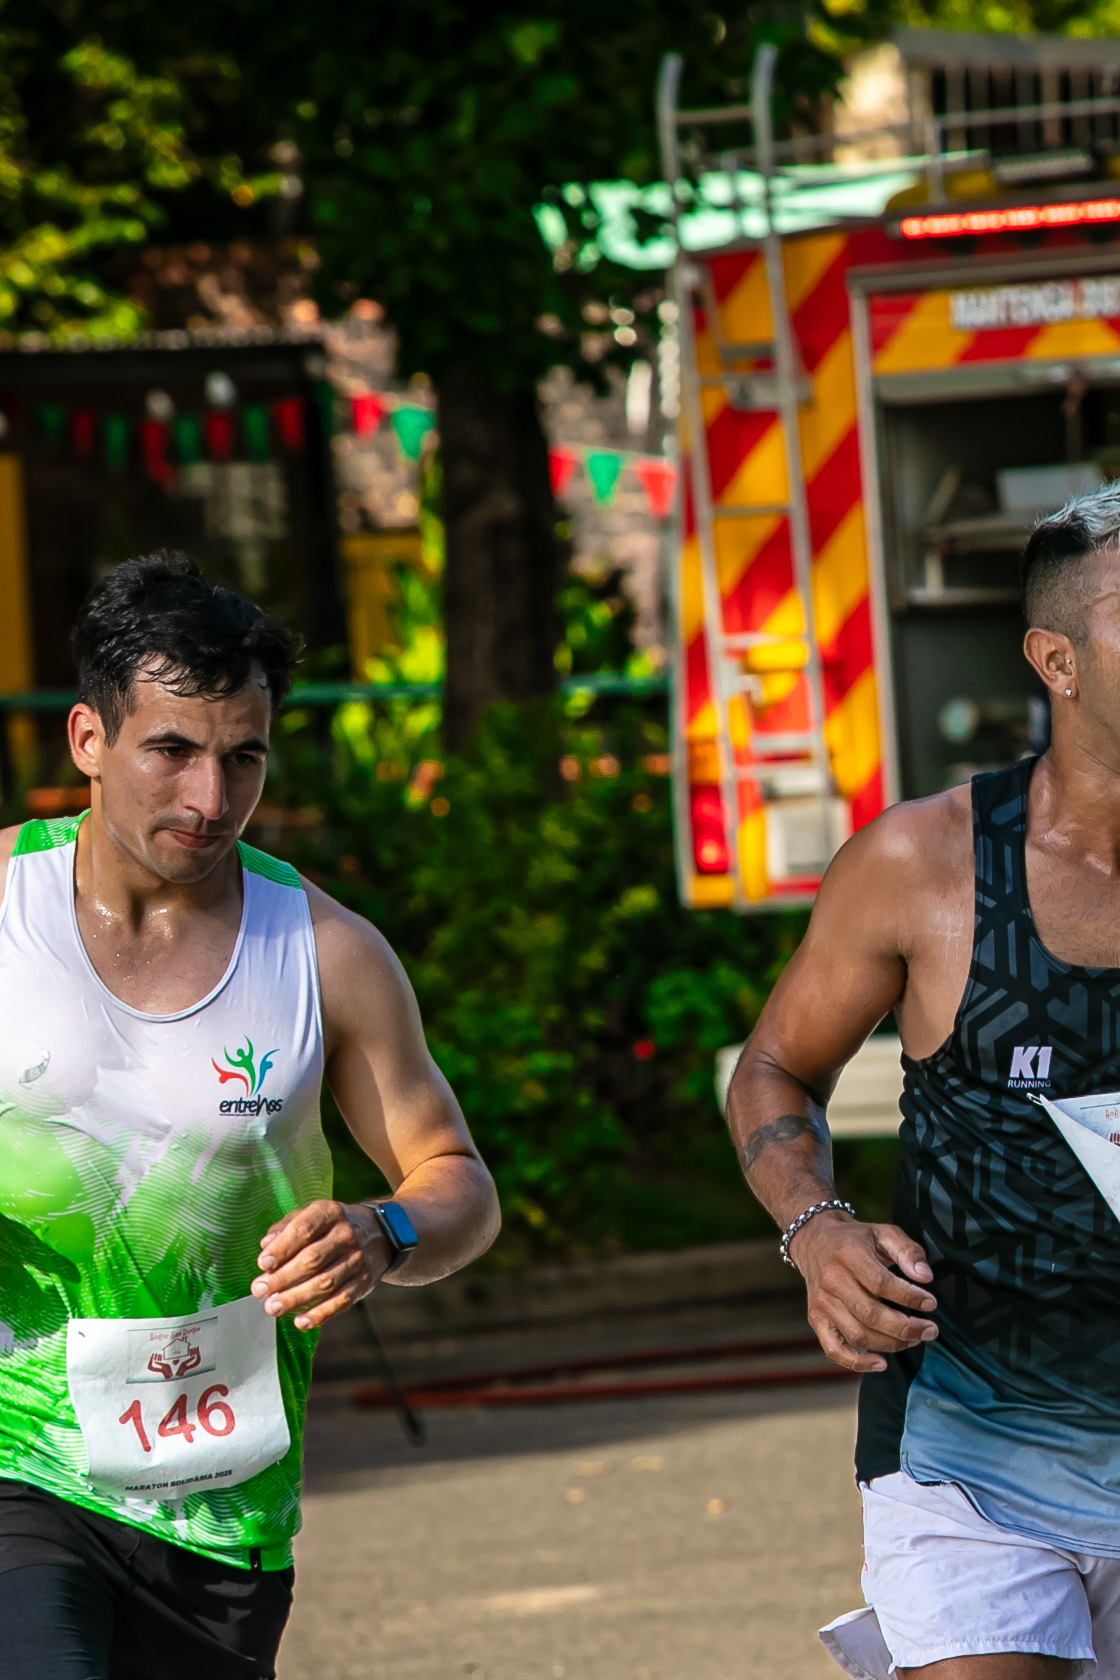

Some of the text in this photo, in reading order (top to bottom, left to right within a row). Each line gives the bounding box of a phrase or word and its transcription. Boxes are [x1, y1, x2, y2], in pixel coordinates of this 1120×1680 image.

[1010, 1046, 1053, 1079] K1
[1007, 1079, 1052, 1089] RUNNING
[119, 1384, 236, 1453] 146
[125, 1469, 233, 1491] MARATON SOLIDARIA 2025
